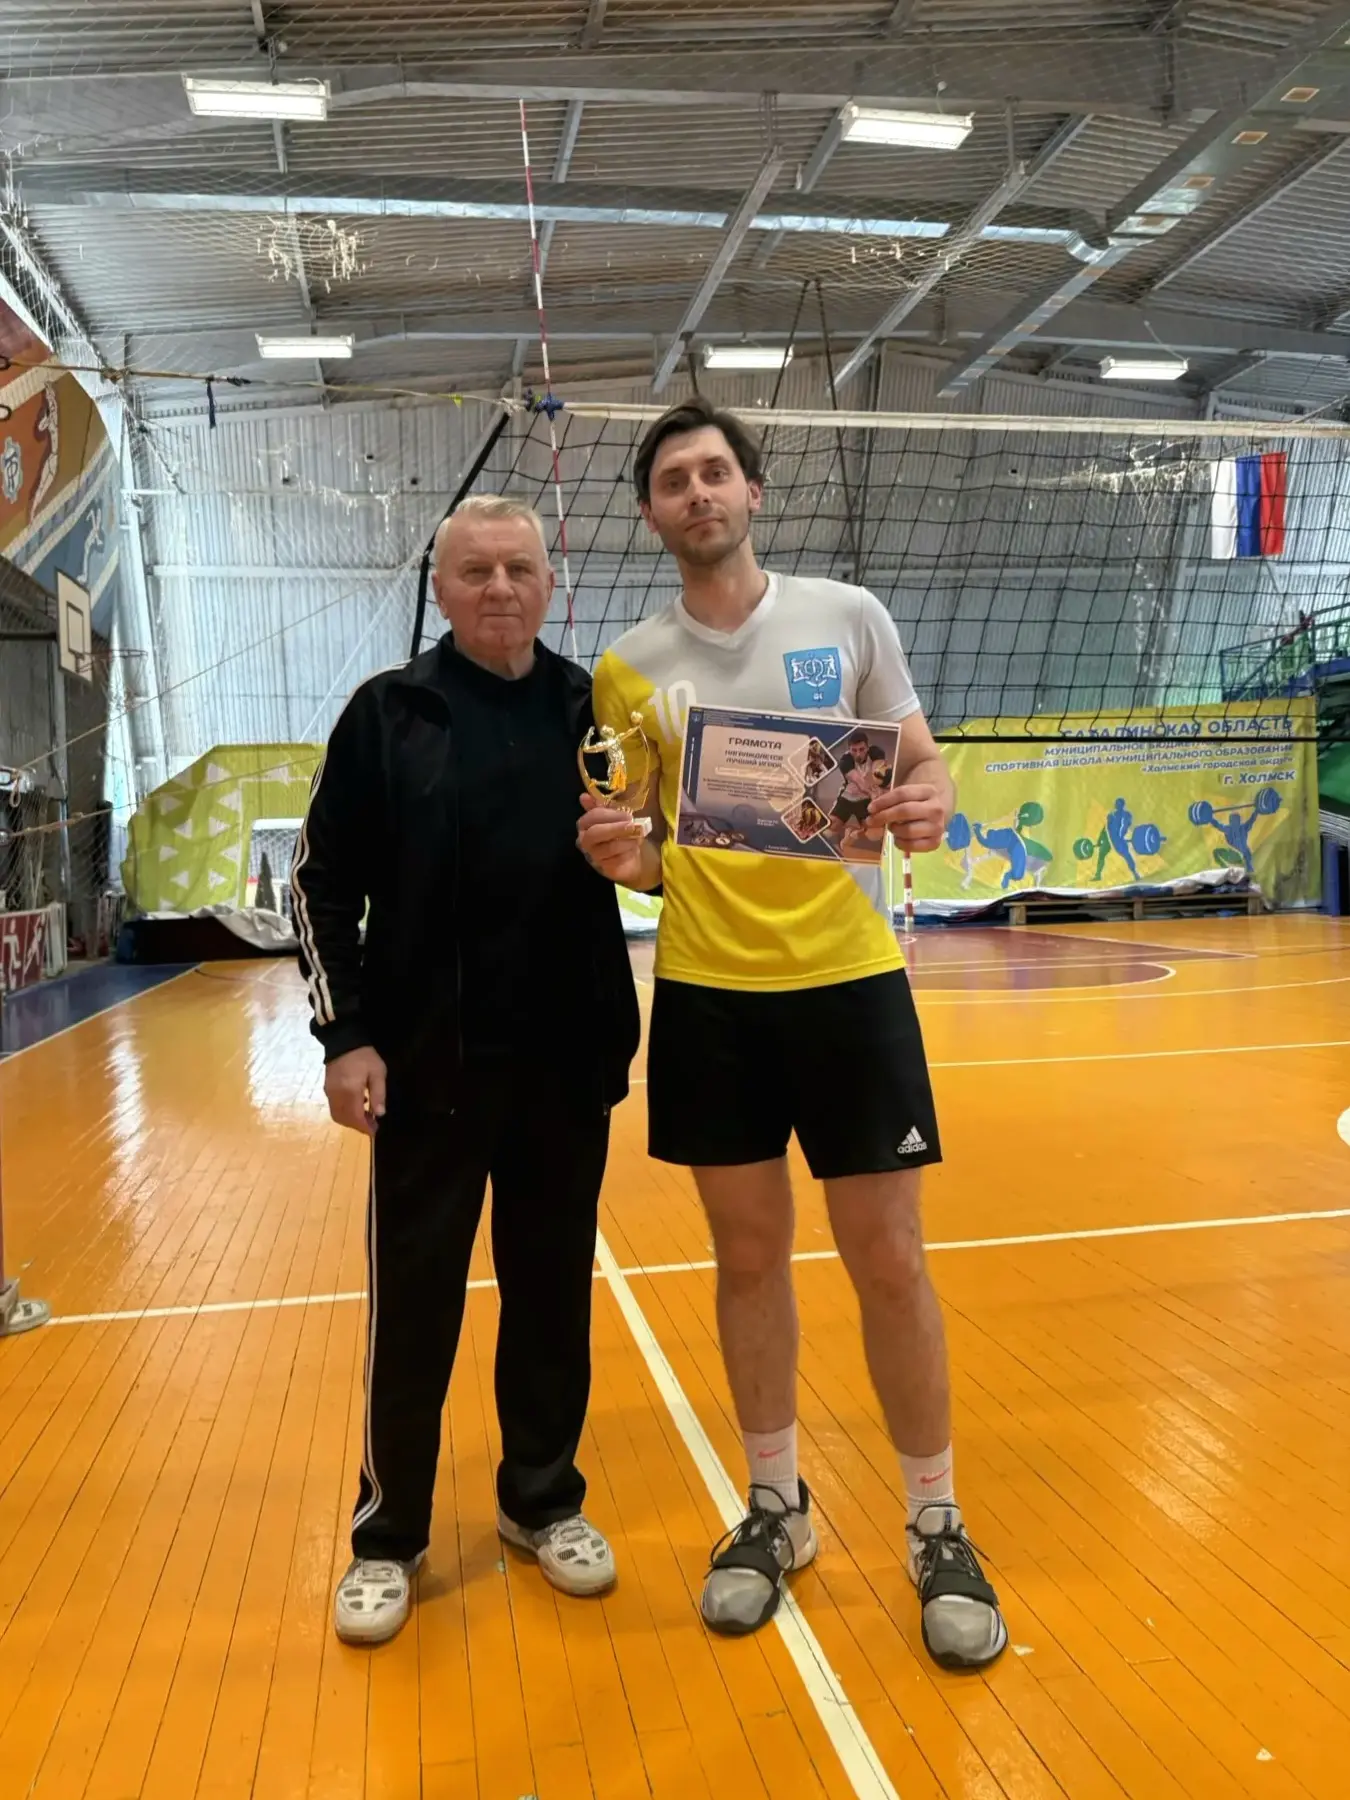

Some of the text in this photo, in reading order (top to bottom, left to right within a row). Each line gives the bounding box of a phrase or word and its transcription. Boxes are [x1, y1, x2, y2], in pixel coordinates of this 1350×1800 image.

[648, 679, 697, 744] 10
[1208, 716, 1292, 734] ОБЛАСТЬ
[728, 737, 782, 750] ГРАМОТА
[985, 758, 1059, 773] СПОРТИВНАЯ
[1062, 756, 1102, 767] ШКОЛА
[1106, 749, 1212, 763] МУНИЦИПАЛЬНОГО
[1203, 757, 1257, 770] городской
[1238, 770, 1295, 784] Холмск
[897, 1141, 928, 1154] adidas
